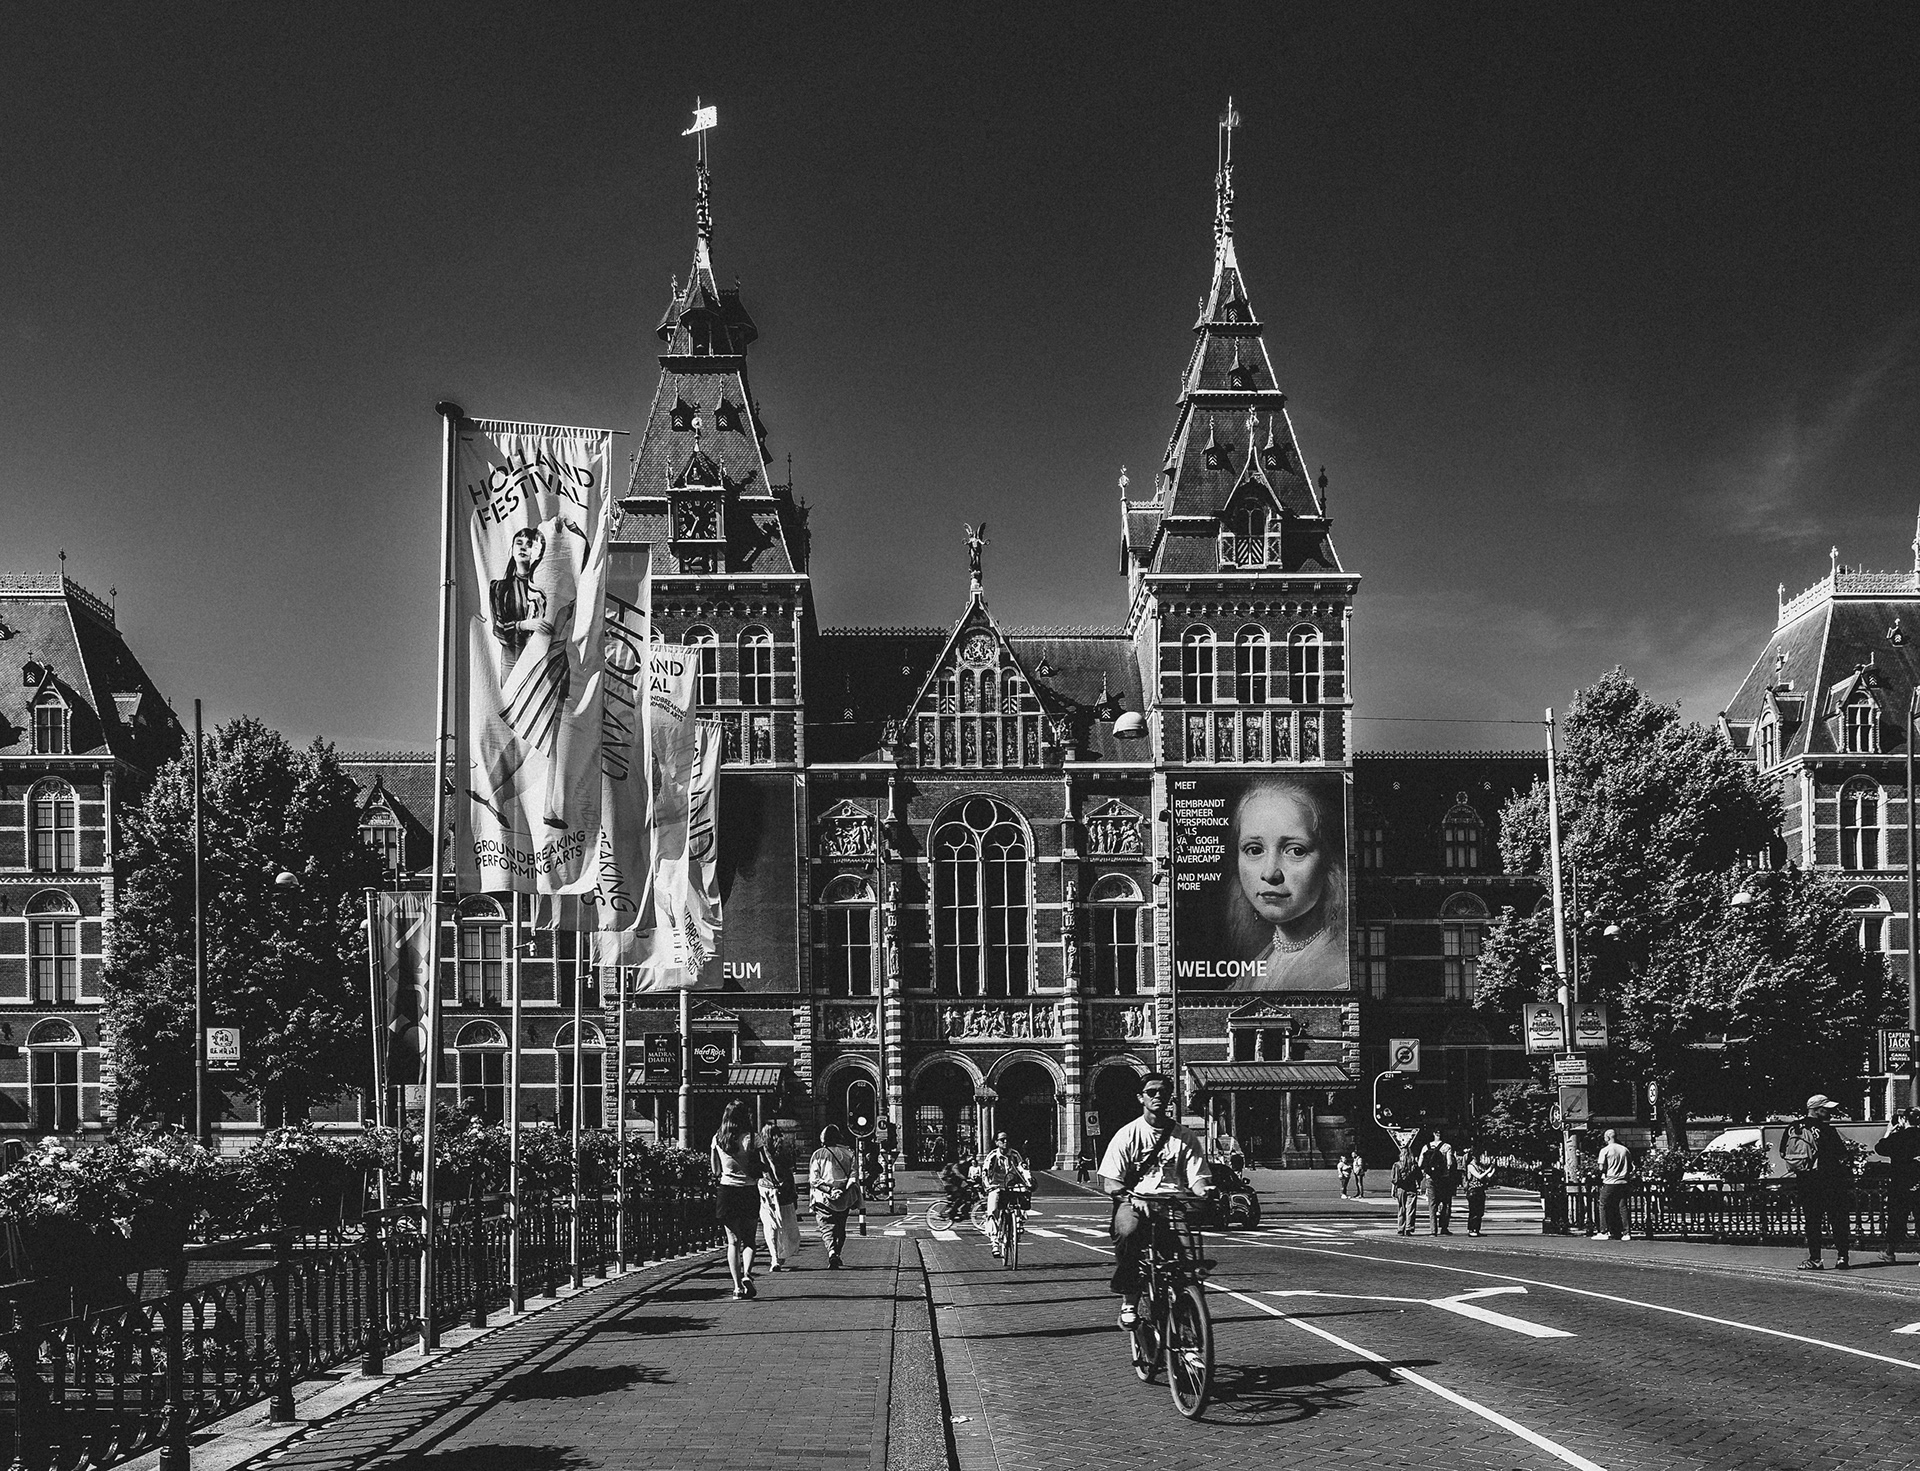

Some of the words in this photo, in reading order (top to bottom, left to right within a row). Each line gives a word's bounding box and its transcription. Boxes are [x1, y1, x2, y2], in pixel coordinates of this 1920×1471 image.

[468, 447, 595, 505] HOLLAND
[477, 471, 589, 530] FESTIVAL
[1174, 781, 1197, 790] MEET
[1175, 799, 1226, 808] REMBRANDT
[1175, 808, 1213, 817] VERMEER
[1175, 817, 1229, 827] VERSPRONCK
[1195, 836, 1219, 845] GOGH
[473, 830, 586, 866] GROUNDBREAKING
[475, 854, 551, 880] PERFORMING
[554, 845, 583, 870] ARTS
[1176, 854, 1221, 864] AVERCAMP
[1177, 873, 1196, 882] AND
[1197, 872, 1222, 881] MANY
[1177, 882, 1201, 891] MORE
[1176, 960, 1268, 978] WELCOME
[1888, 1038, 1911, 1048] JACK
[710, 1047, 726, 1056] Rock
